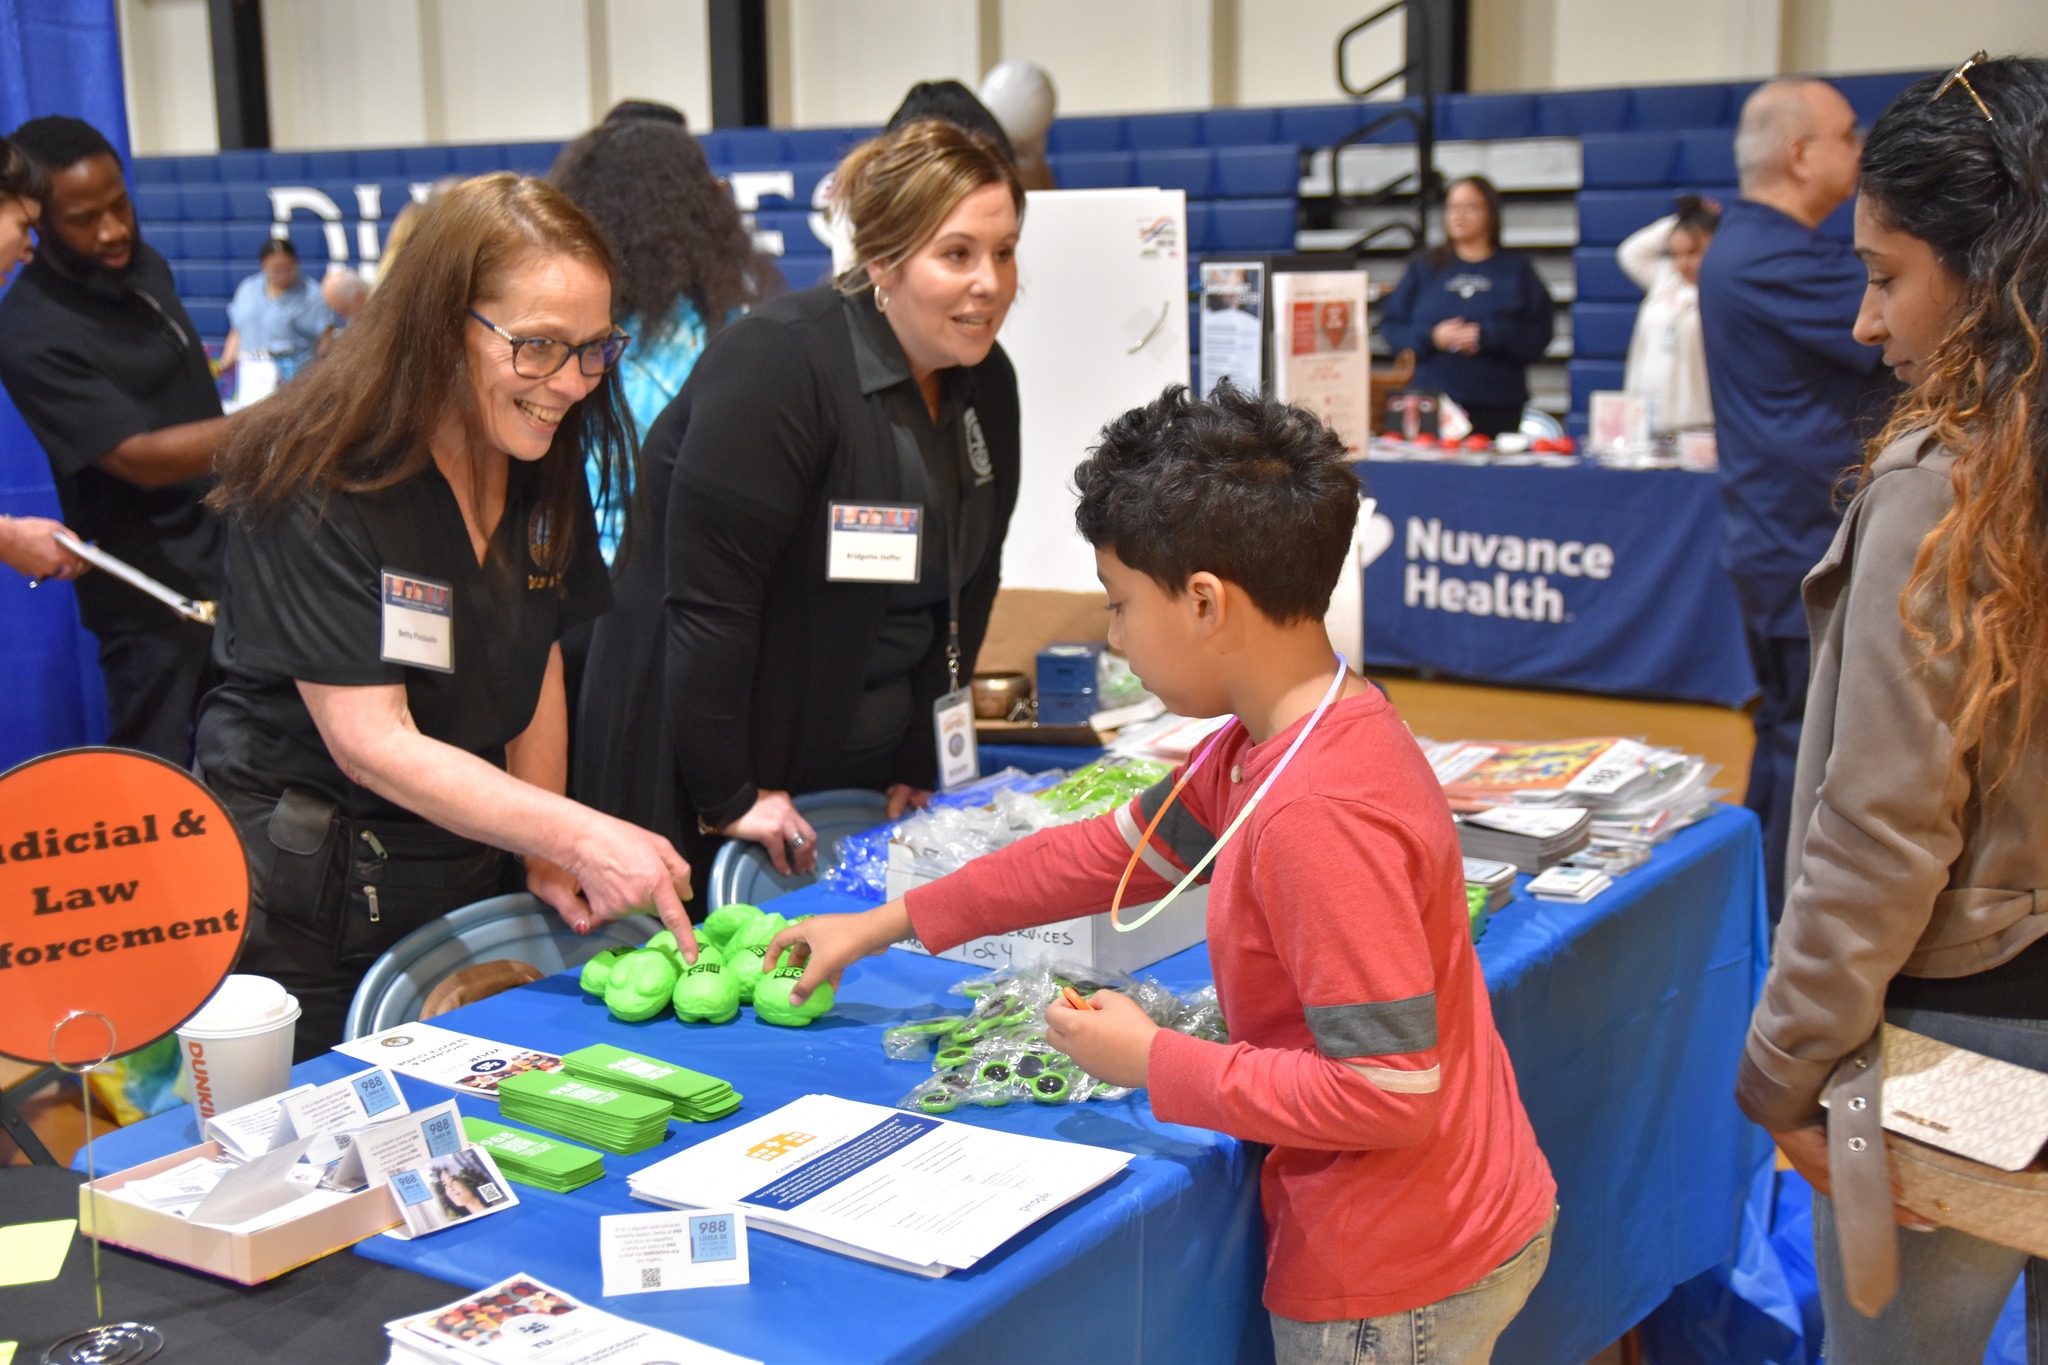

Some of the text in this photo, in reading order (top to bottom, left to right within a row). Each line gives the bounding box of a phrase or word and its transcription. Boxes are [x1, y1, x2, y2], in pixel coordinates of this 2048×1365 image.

[1406, 515, 1615, 580] Nuvance
[1404, 564, 1564, 623] Health
[0, 809, 206, 864] dicial &
[32, 880, 140, 916] Law
[973, 942, 998, 960] of
[361, 1076, 383, 1092] 988
[429, 1118, 450, 1135] 988
[398, 1174, 417, 1187] 988
[698, 1220, 727, 1234] 988
